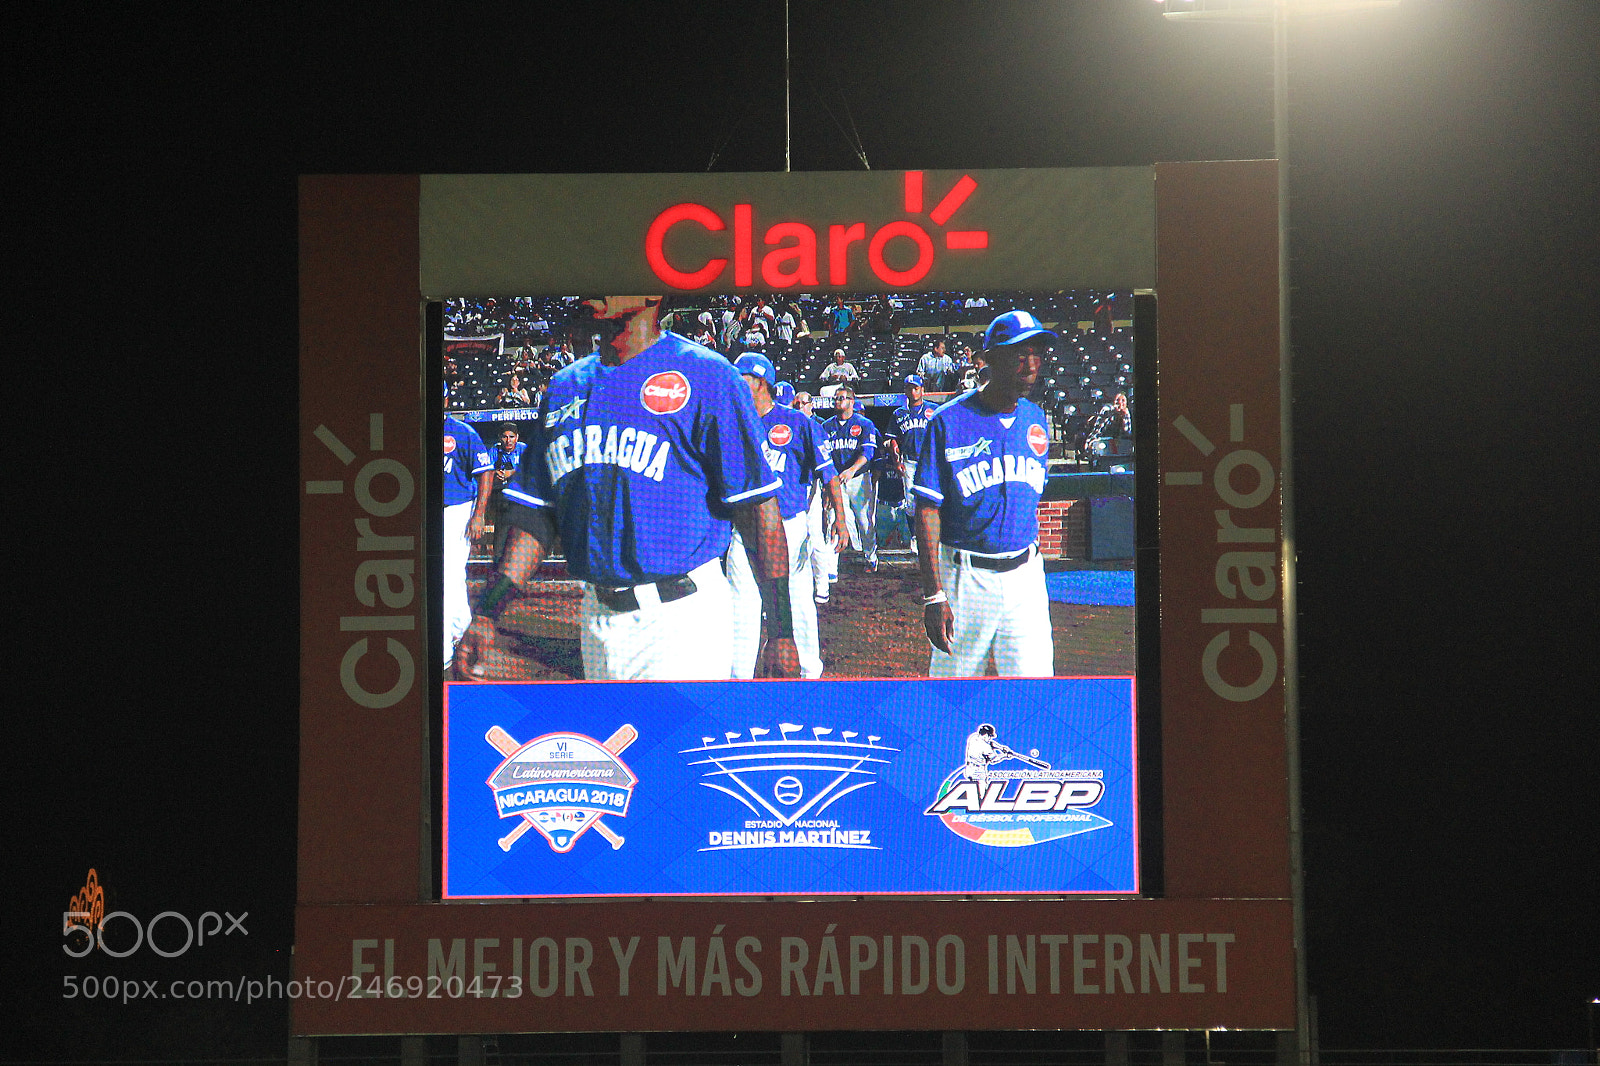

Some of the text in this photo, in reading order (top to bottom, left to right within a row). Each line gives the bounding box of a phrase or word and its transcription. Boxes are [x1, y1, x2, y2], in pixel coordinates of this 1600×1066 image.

[645, 202, 935, 290] Claro
[491, 411, 539, 421] PERFECTO
[340, 458, 415, 709] Claro
[1201, 449, 1278, 702] Claro
[549, 751, 574, 759] SERIE
[556, 742, 568, 752] VI
[512, 765, 615, 779] Latinoamericana
[1033, 770, 1103, 778] LATINOAMERICANA
[499, 788, 625, 809] NICARAGUA 2018
[926, 780, 1104, 813] ALBP
[745, 819, 841, 829] ESTADIO NACIONAL
[952, 814, 968, 822] DE
[1016, 814, 1092, 822] PROFESIONAL
[709, 827, 871, 846] DENNIS MARTÍNEZ
[351, 923, 1236, 999] EL MEJOR Y MÁS RÁPIDO INTERNET
